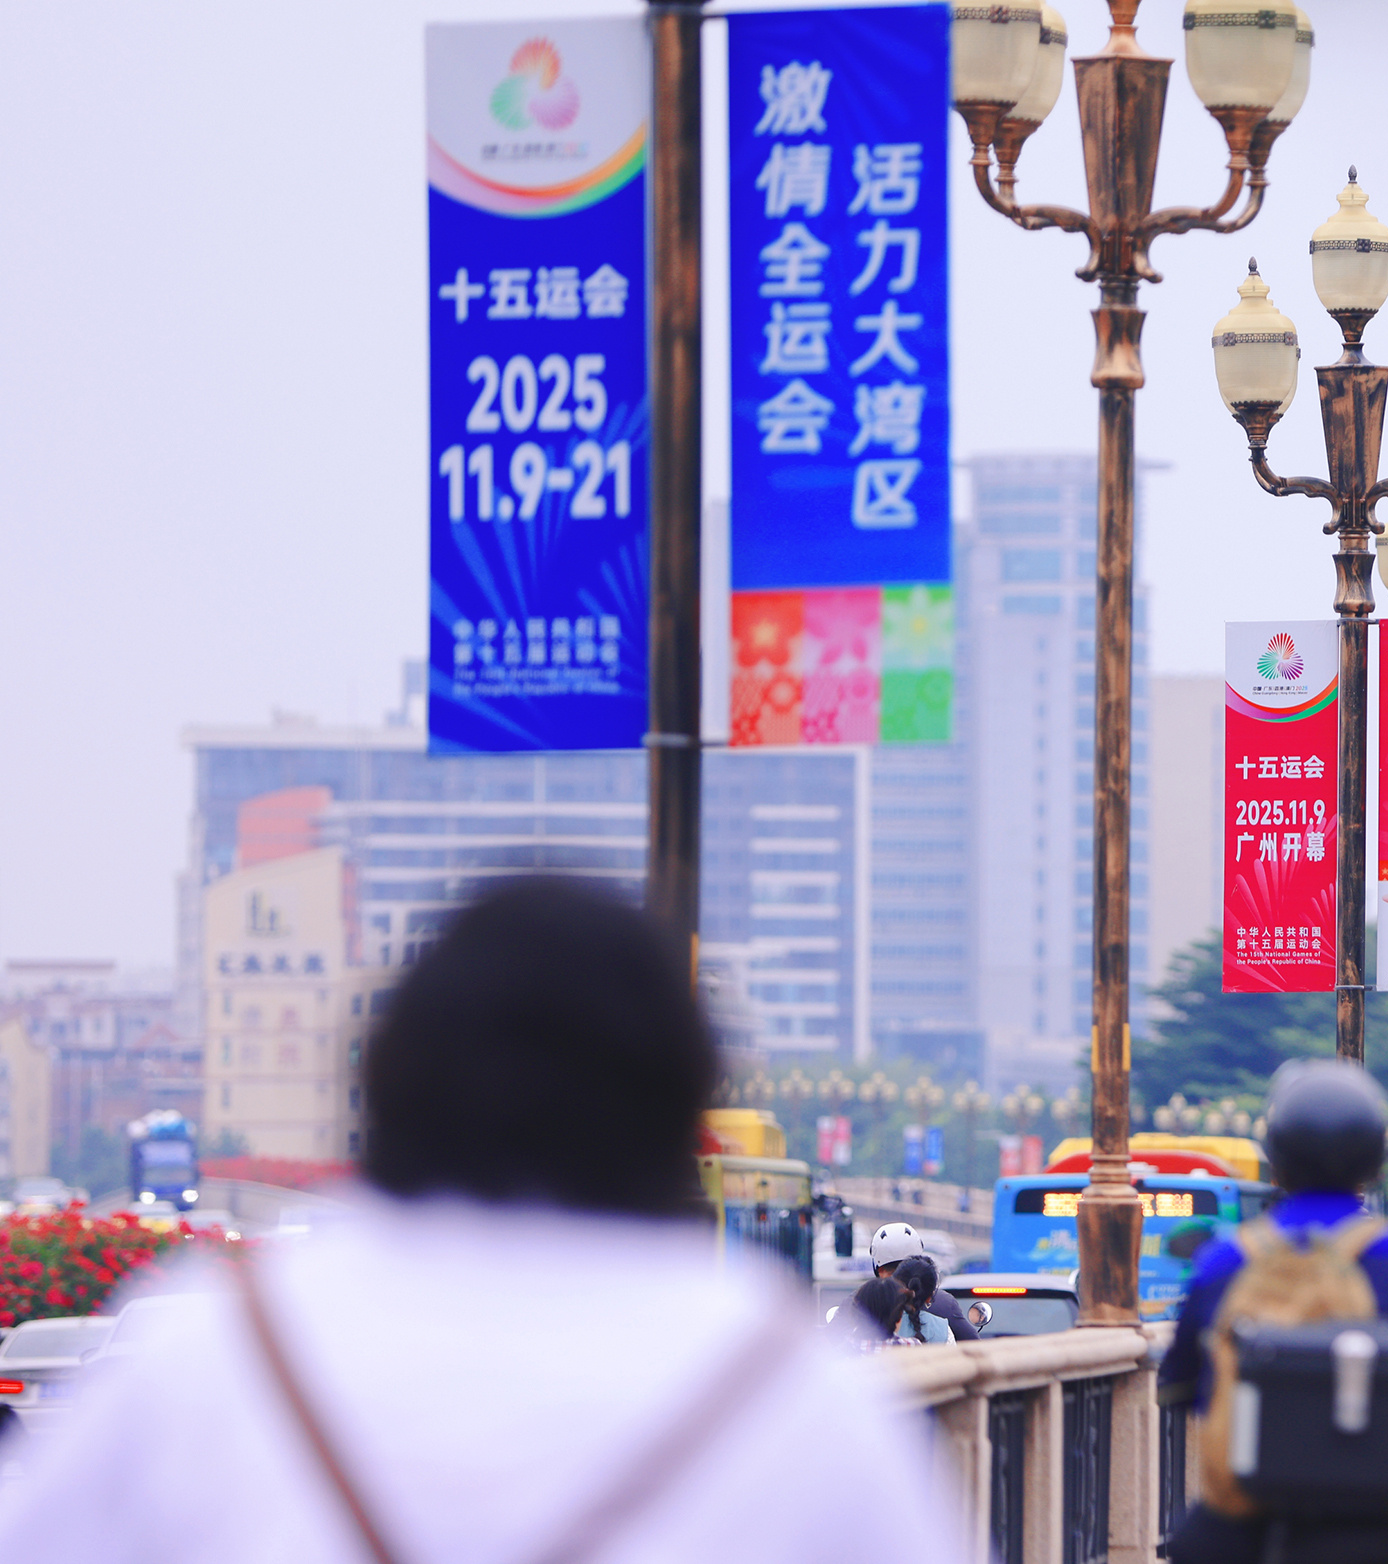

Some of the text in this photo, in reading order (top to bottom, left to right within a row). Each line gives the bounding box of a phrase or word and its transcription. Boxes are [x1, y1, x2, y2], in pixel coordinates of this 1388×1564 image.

[754, 60, 834, 456] 激情全运会
[438, 263, 630, 322] 十五运会
[849, 142, 927, 530] 活力大湾区
[466, 354, 608, 434] 2025
[439, 440, 632, 522] 11.9-21
[1235, 755, 1325, 780] 十五运会
[1235, 799, 1325, 826] 2025.11.9
[1235, 831, 1325, 863] 广州开幕
[1236, 926, 1321, 938] 中华人民共和国
[1236, 938, 1321, 950] 第十五届运动会
